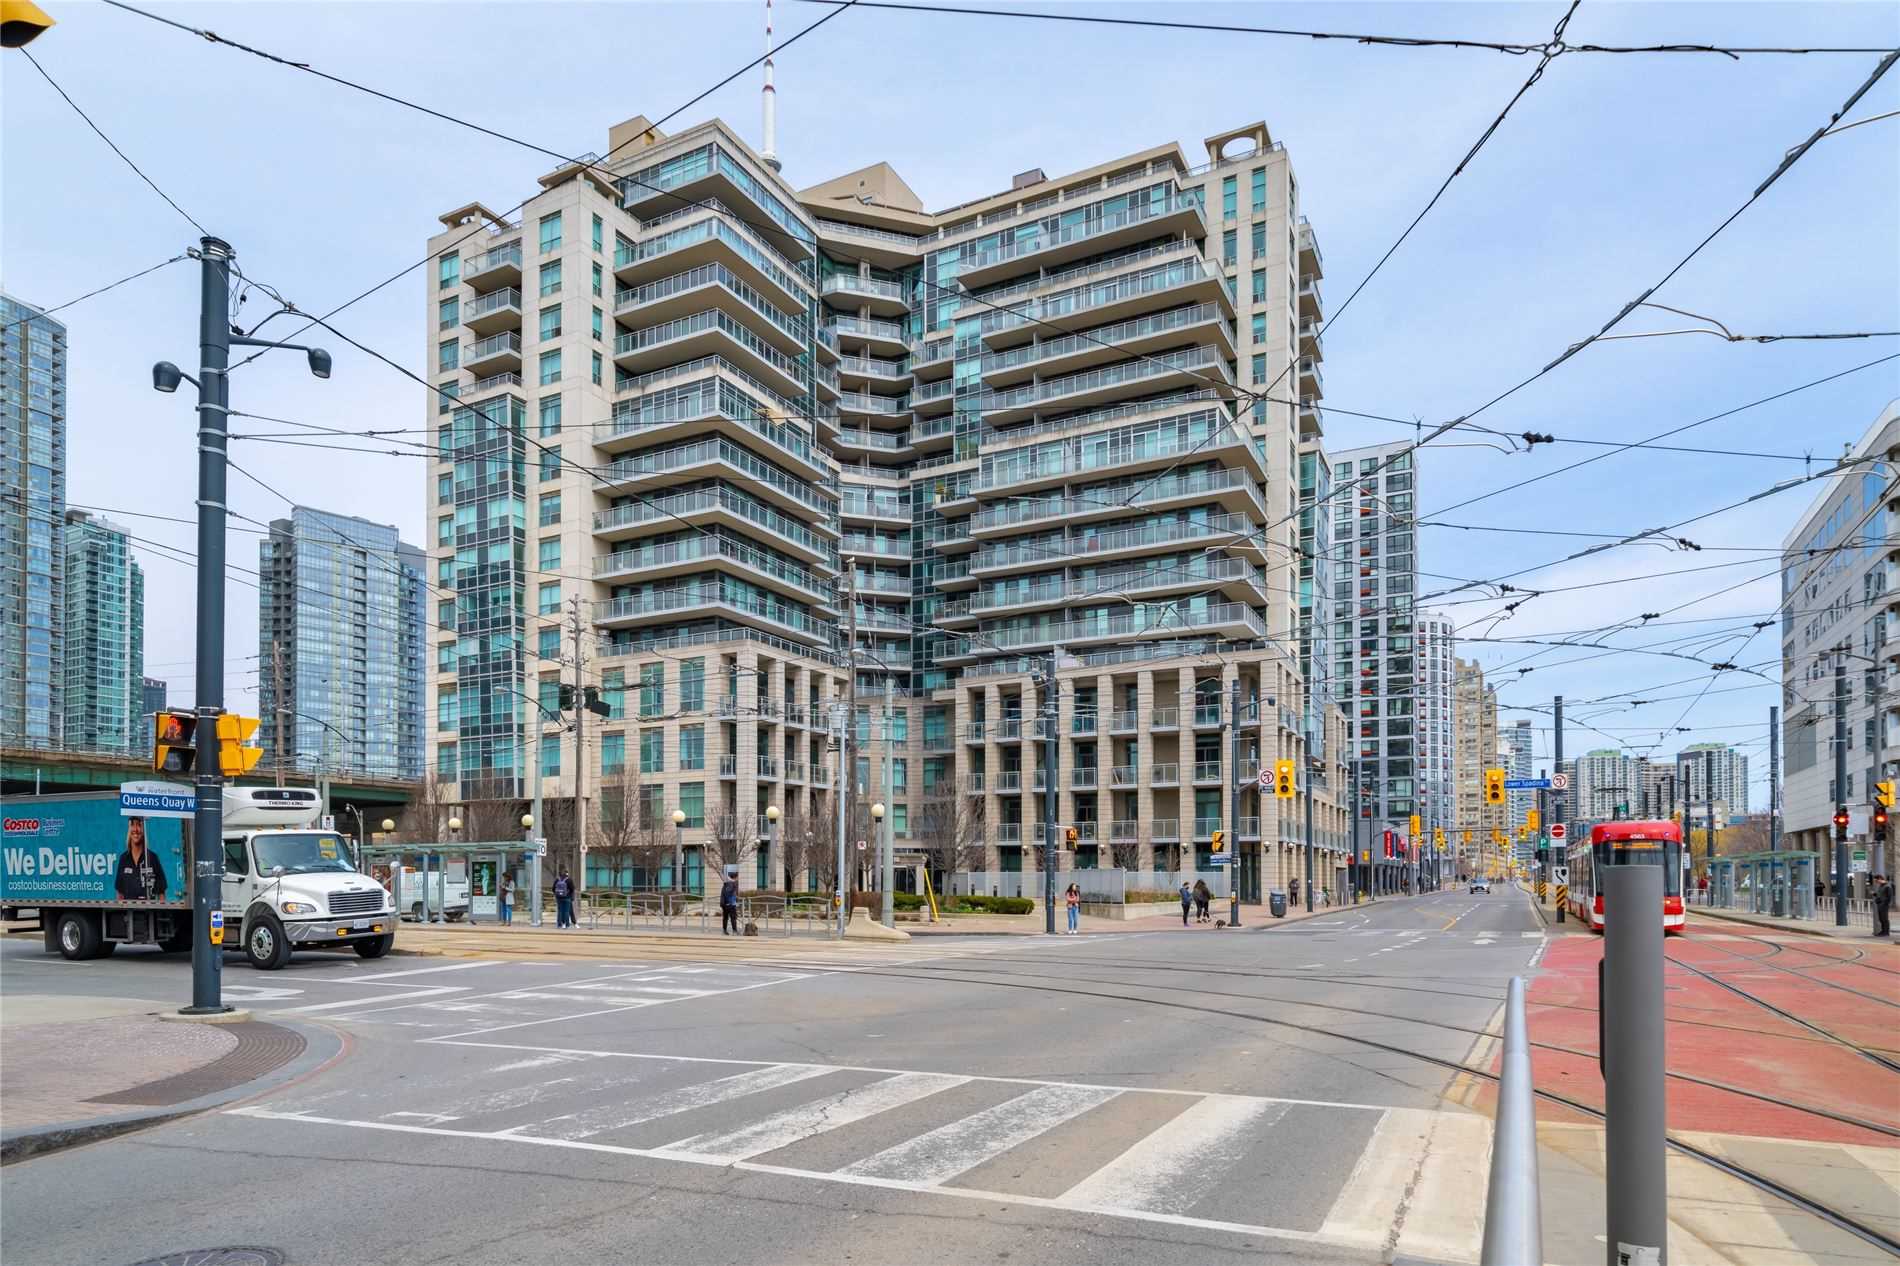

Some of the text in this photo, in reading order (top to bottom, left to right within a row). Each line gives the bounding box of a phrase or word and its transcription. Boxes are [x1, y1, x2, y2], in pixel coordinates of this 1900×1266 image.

[122, 794, 195, 810] Queens Quay W
[3, 817, 39, 831] COSTCO
[4, 847, 117, 876] We Deliver
[8, 879, 104, 891] costcobusinesscentre.ca
